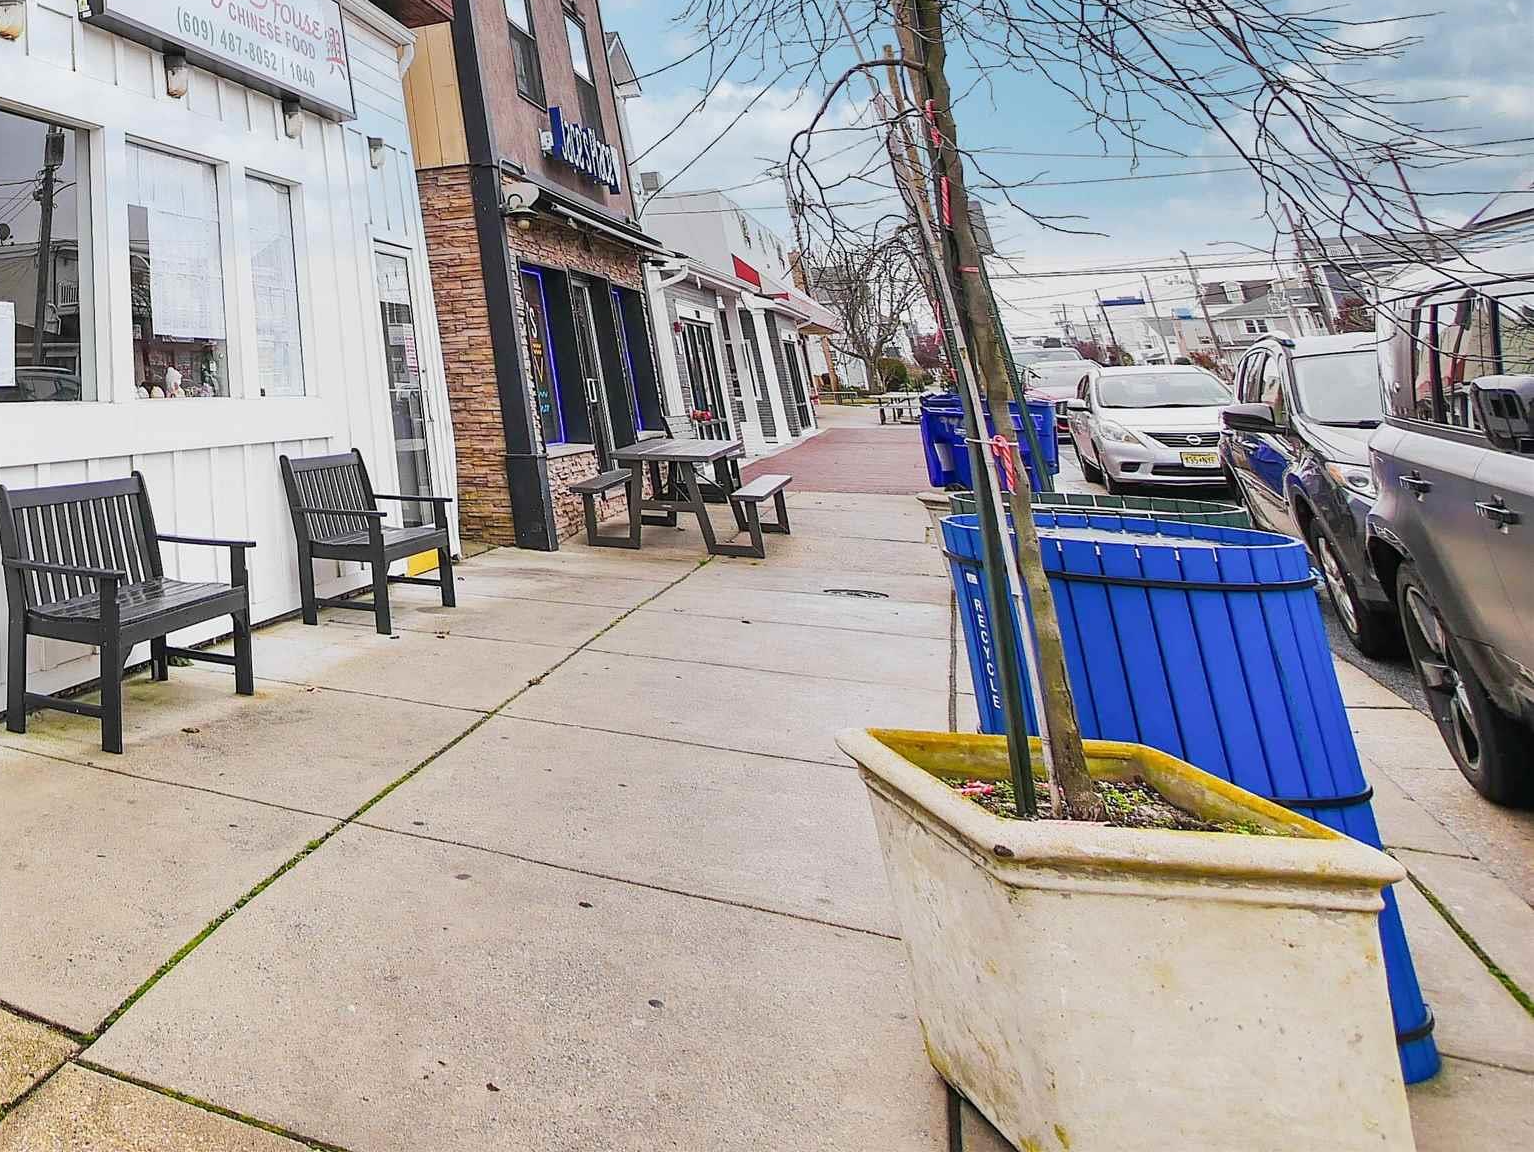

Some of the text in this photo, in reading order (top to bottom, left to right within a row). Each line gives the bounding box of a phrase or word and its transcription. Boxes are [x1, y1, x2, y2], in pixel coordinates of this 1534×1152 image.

[177, 7, 214, 46] (609)
[228, 2, 316, 59] CHINESE FOOD
[973, 598, 1002, 710] RECYCLE
